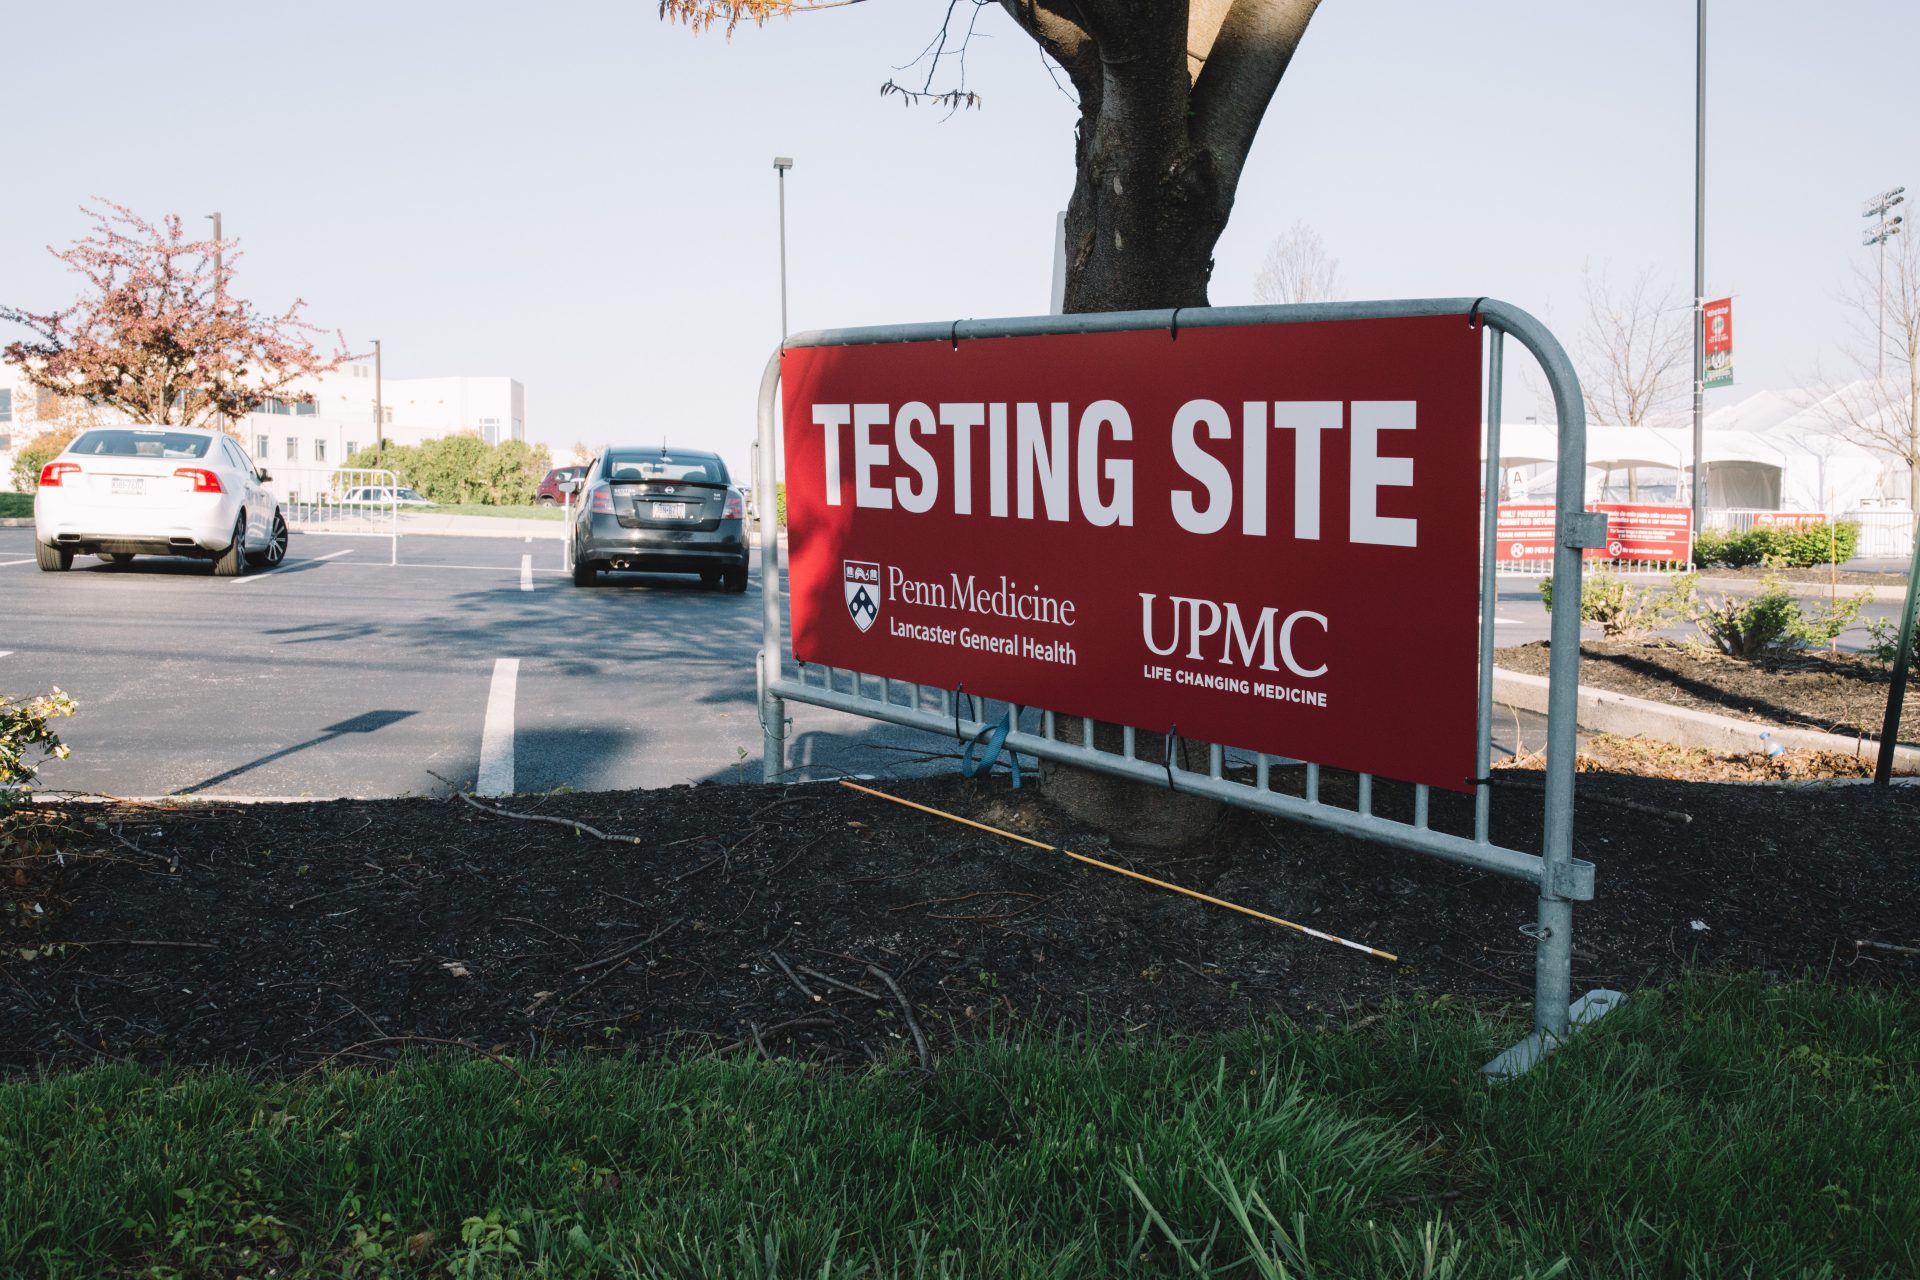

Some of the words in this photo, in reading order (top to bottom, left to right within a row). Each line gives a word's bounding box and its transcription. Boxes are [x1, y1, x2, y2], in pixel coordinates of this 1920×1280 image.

[811, 400, 1134, 528] TESTING
[1170, 398, 1418, 548] SITE
[1514, 471, 1522, 484] A
[1525, 546, 1533, 554] NO
[1534, 546, 1549, 554] PETS
[888, 565, 947, 609] Penn
[950, 573, 1076, 626] Medicine
[890, 616, 957, 645] Lancaster
[959, 627, 1018, 656] General
[1022, 636, 1077, 666] Health
[1139, 592, 1329, 678] UPMC
[1143, 664, 1172, 682] LIFE
[1175, 669, 1250, 694] CHANGING
[1253, 682, 1328, 708] MEDICINE
